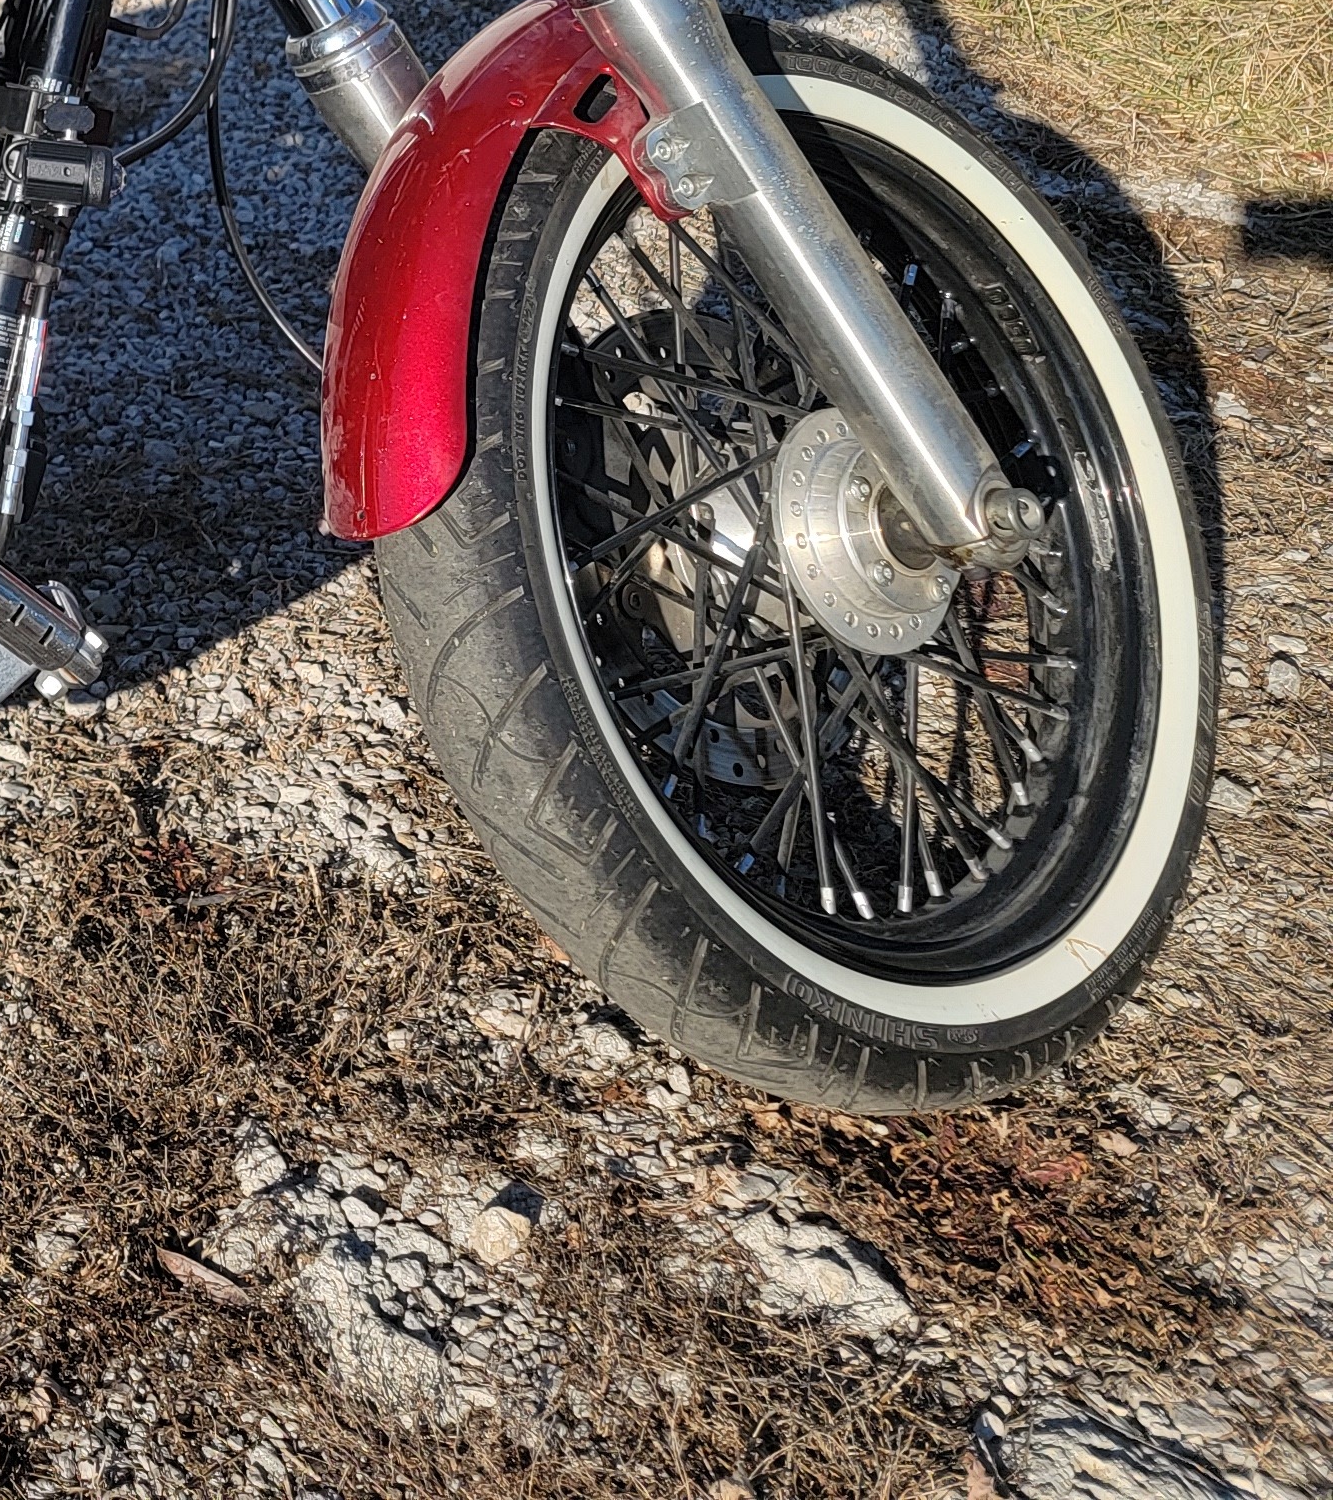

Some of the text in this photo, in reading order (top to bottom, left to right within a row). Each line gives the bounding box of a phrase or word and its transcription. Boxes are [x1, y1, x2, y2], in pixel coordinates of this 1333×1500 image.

[1087, 275, 1123, 334] TUBELESS
[516, 448, 528, 481] DOT
[785, 972, 939, 1049] SHINKO
